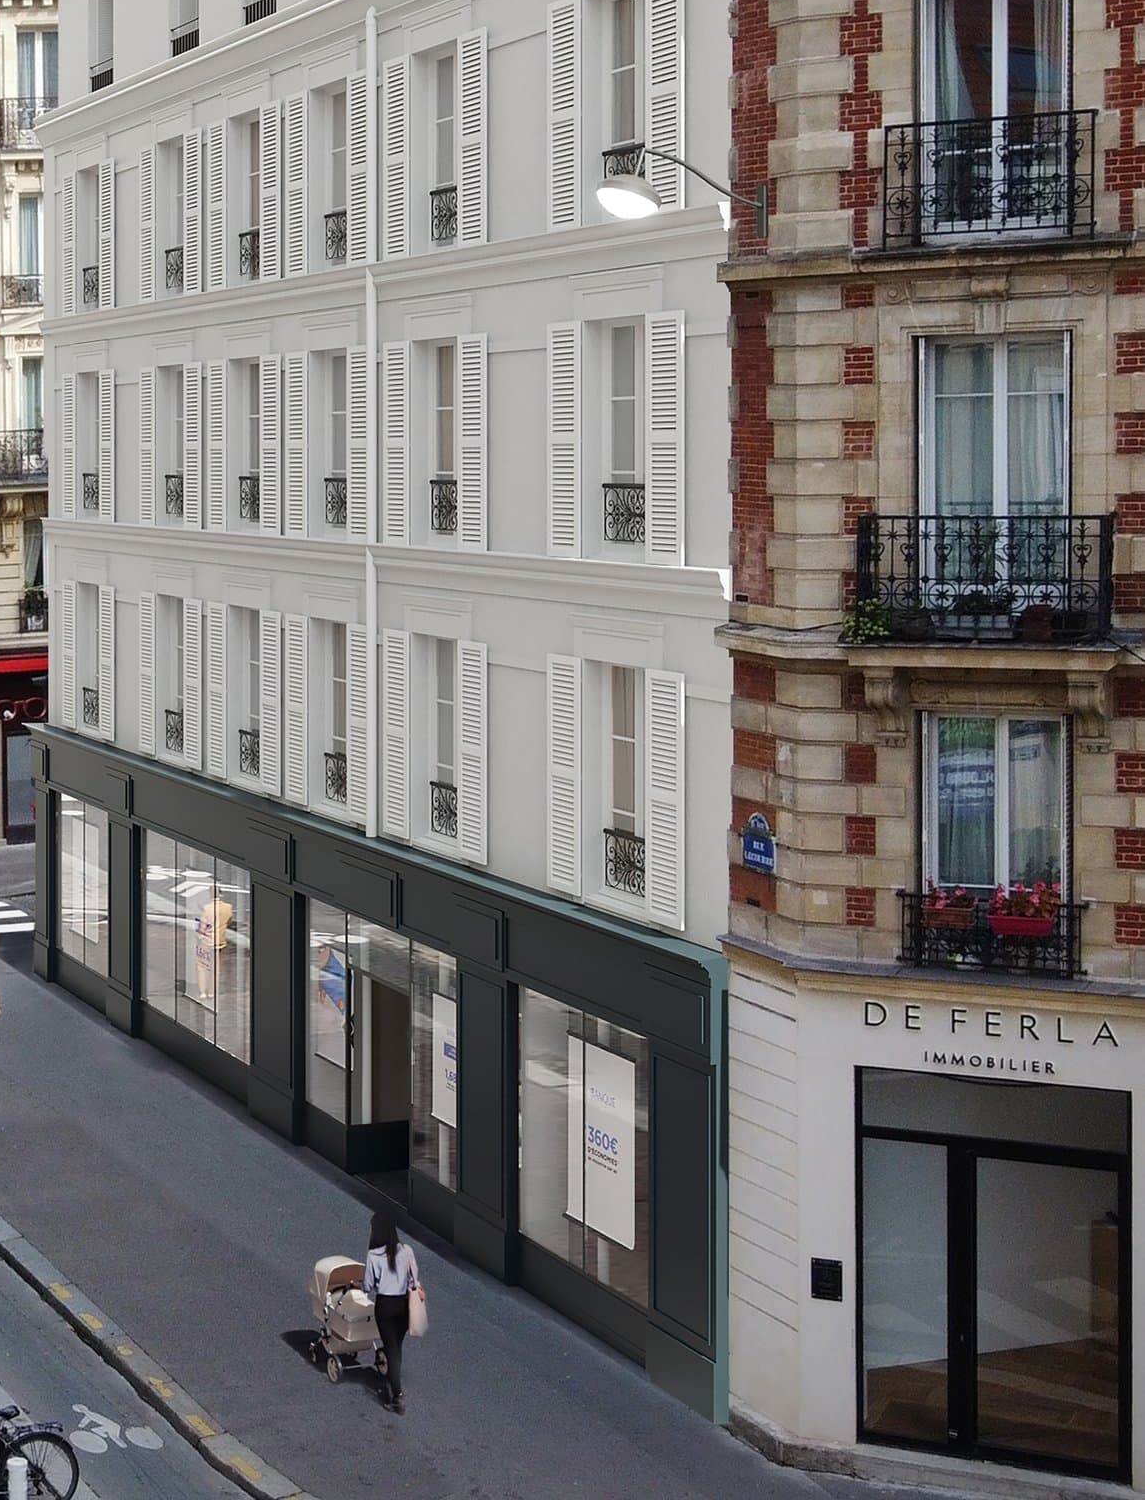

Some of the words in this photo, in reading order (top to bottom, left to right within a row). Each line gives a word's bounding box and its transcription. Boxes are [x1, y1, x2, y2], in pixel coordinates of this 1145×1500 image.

[864, 1001, 921, 1030] DE
[951, 1008, 1119, 1047] FERLA
[924, 1050, 1055, 1075] IMMOBILIER
[588, 1124, 618, 1155] 360€
